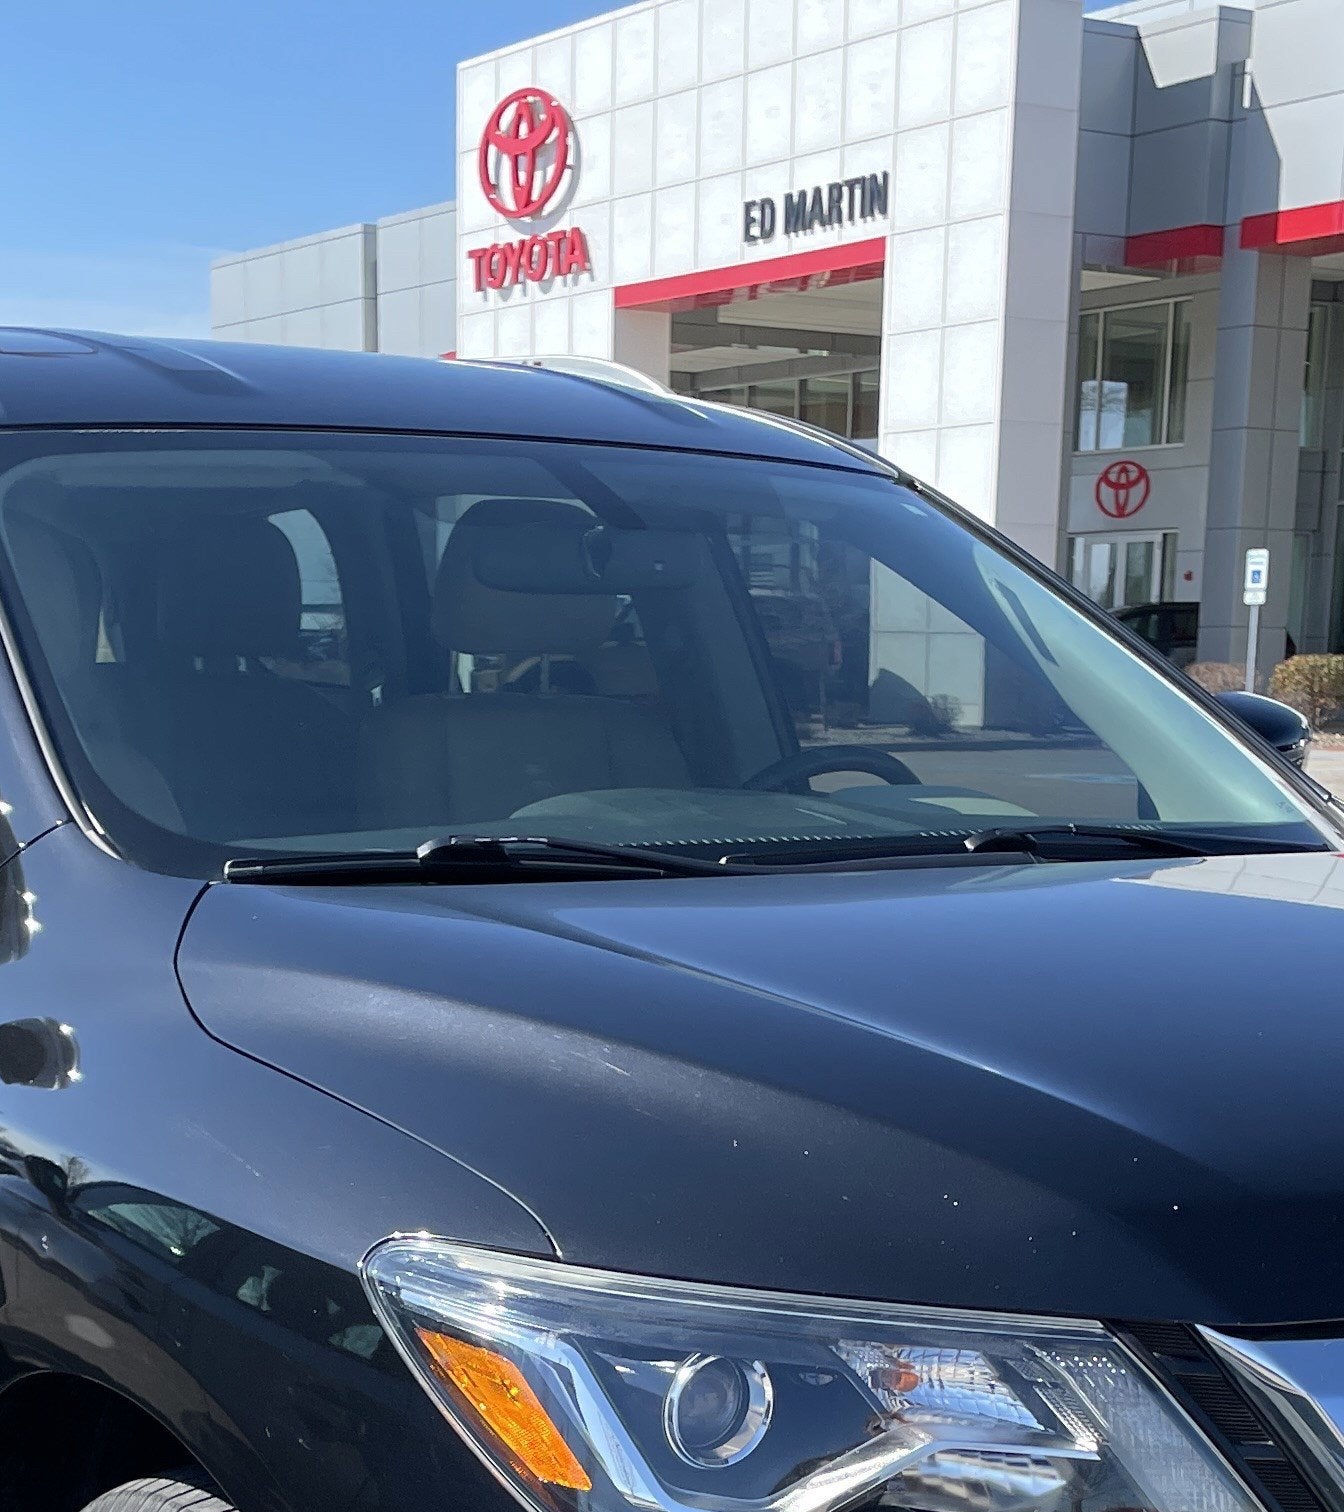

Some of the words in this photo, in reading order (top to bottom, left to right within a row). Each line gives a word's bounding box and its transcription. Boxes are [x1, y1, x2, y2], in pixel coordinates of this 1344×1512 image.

[744, 197, 776, 242] ED
[784, 170, 889, 236] MARTIN
[467, 227, 592, 293] TOYOTA
